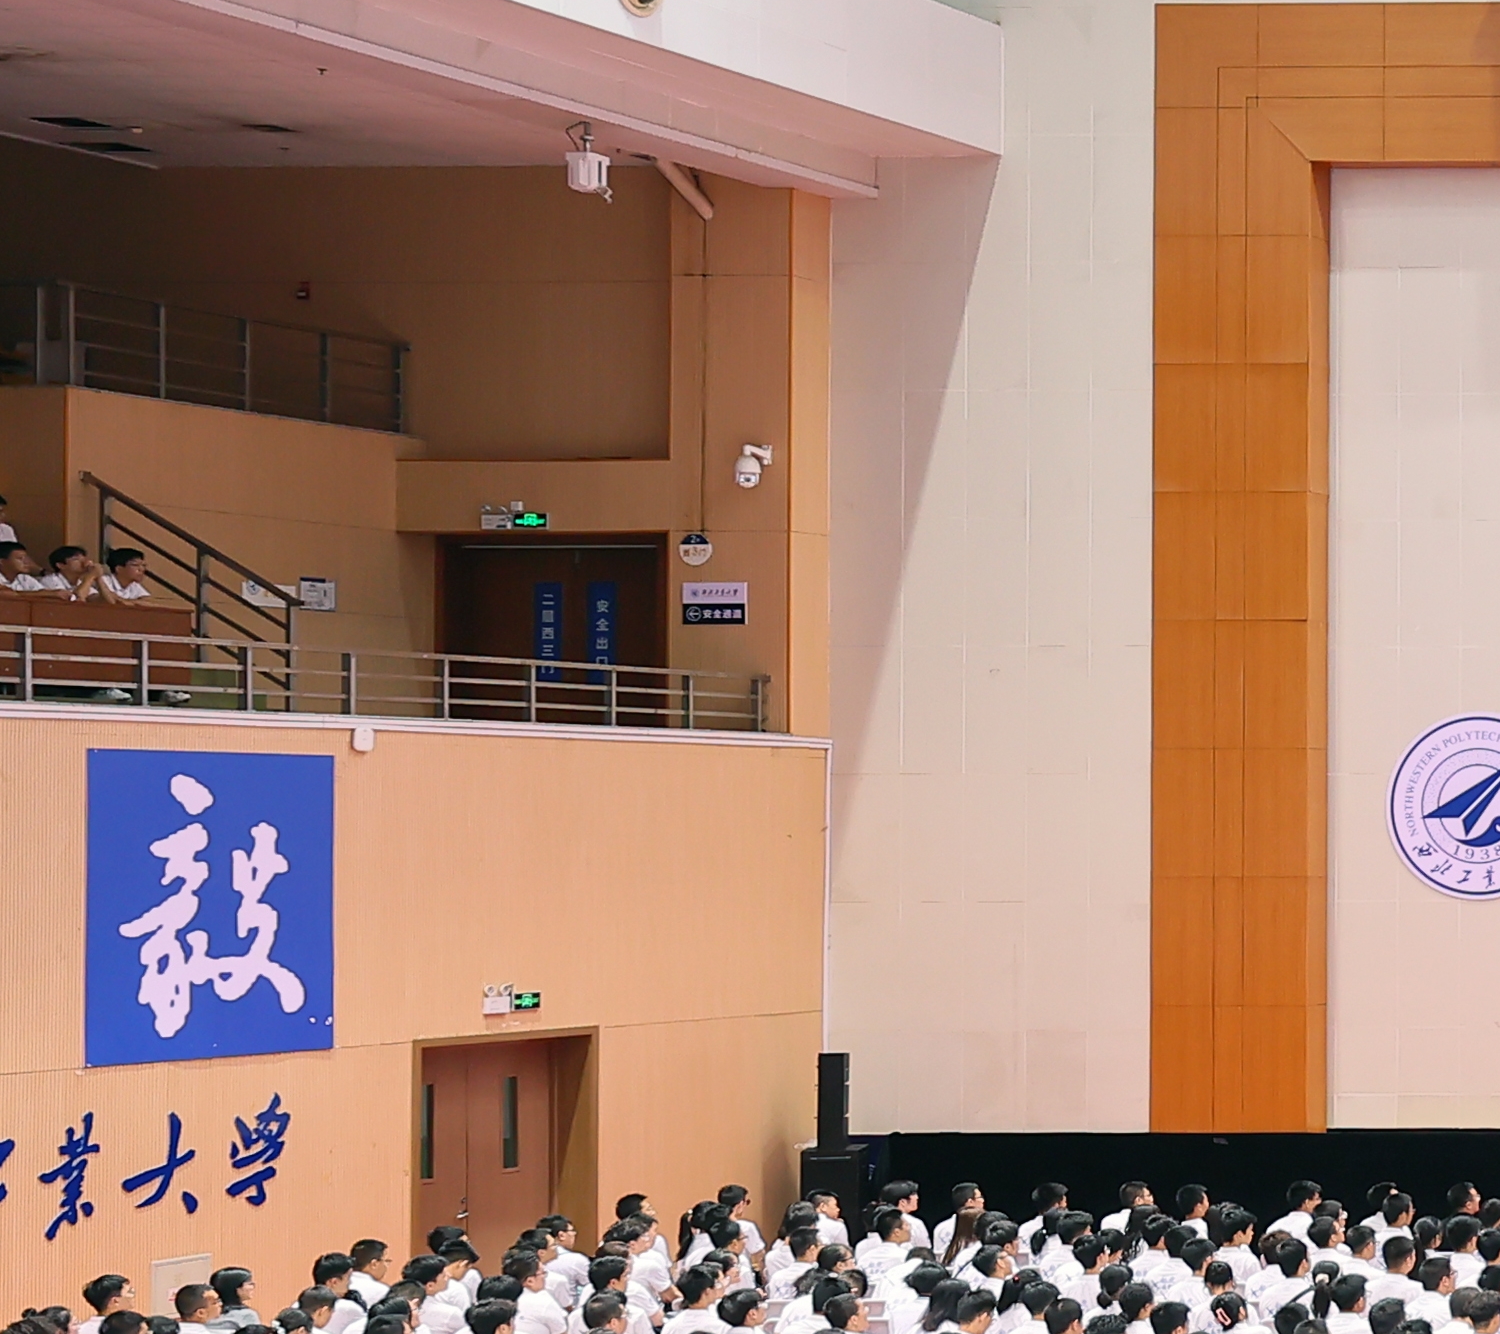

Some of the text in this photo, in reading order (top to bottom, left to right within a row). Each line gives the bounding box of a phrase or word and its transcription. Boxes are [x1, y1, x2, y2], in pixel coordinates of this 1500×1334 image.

[702, 609, 742, 619] 安全通道
[1404, 744, 1441, 838] NORTHWESTERN
